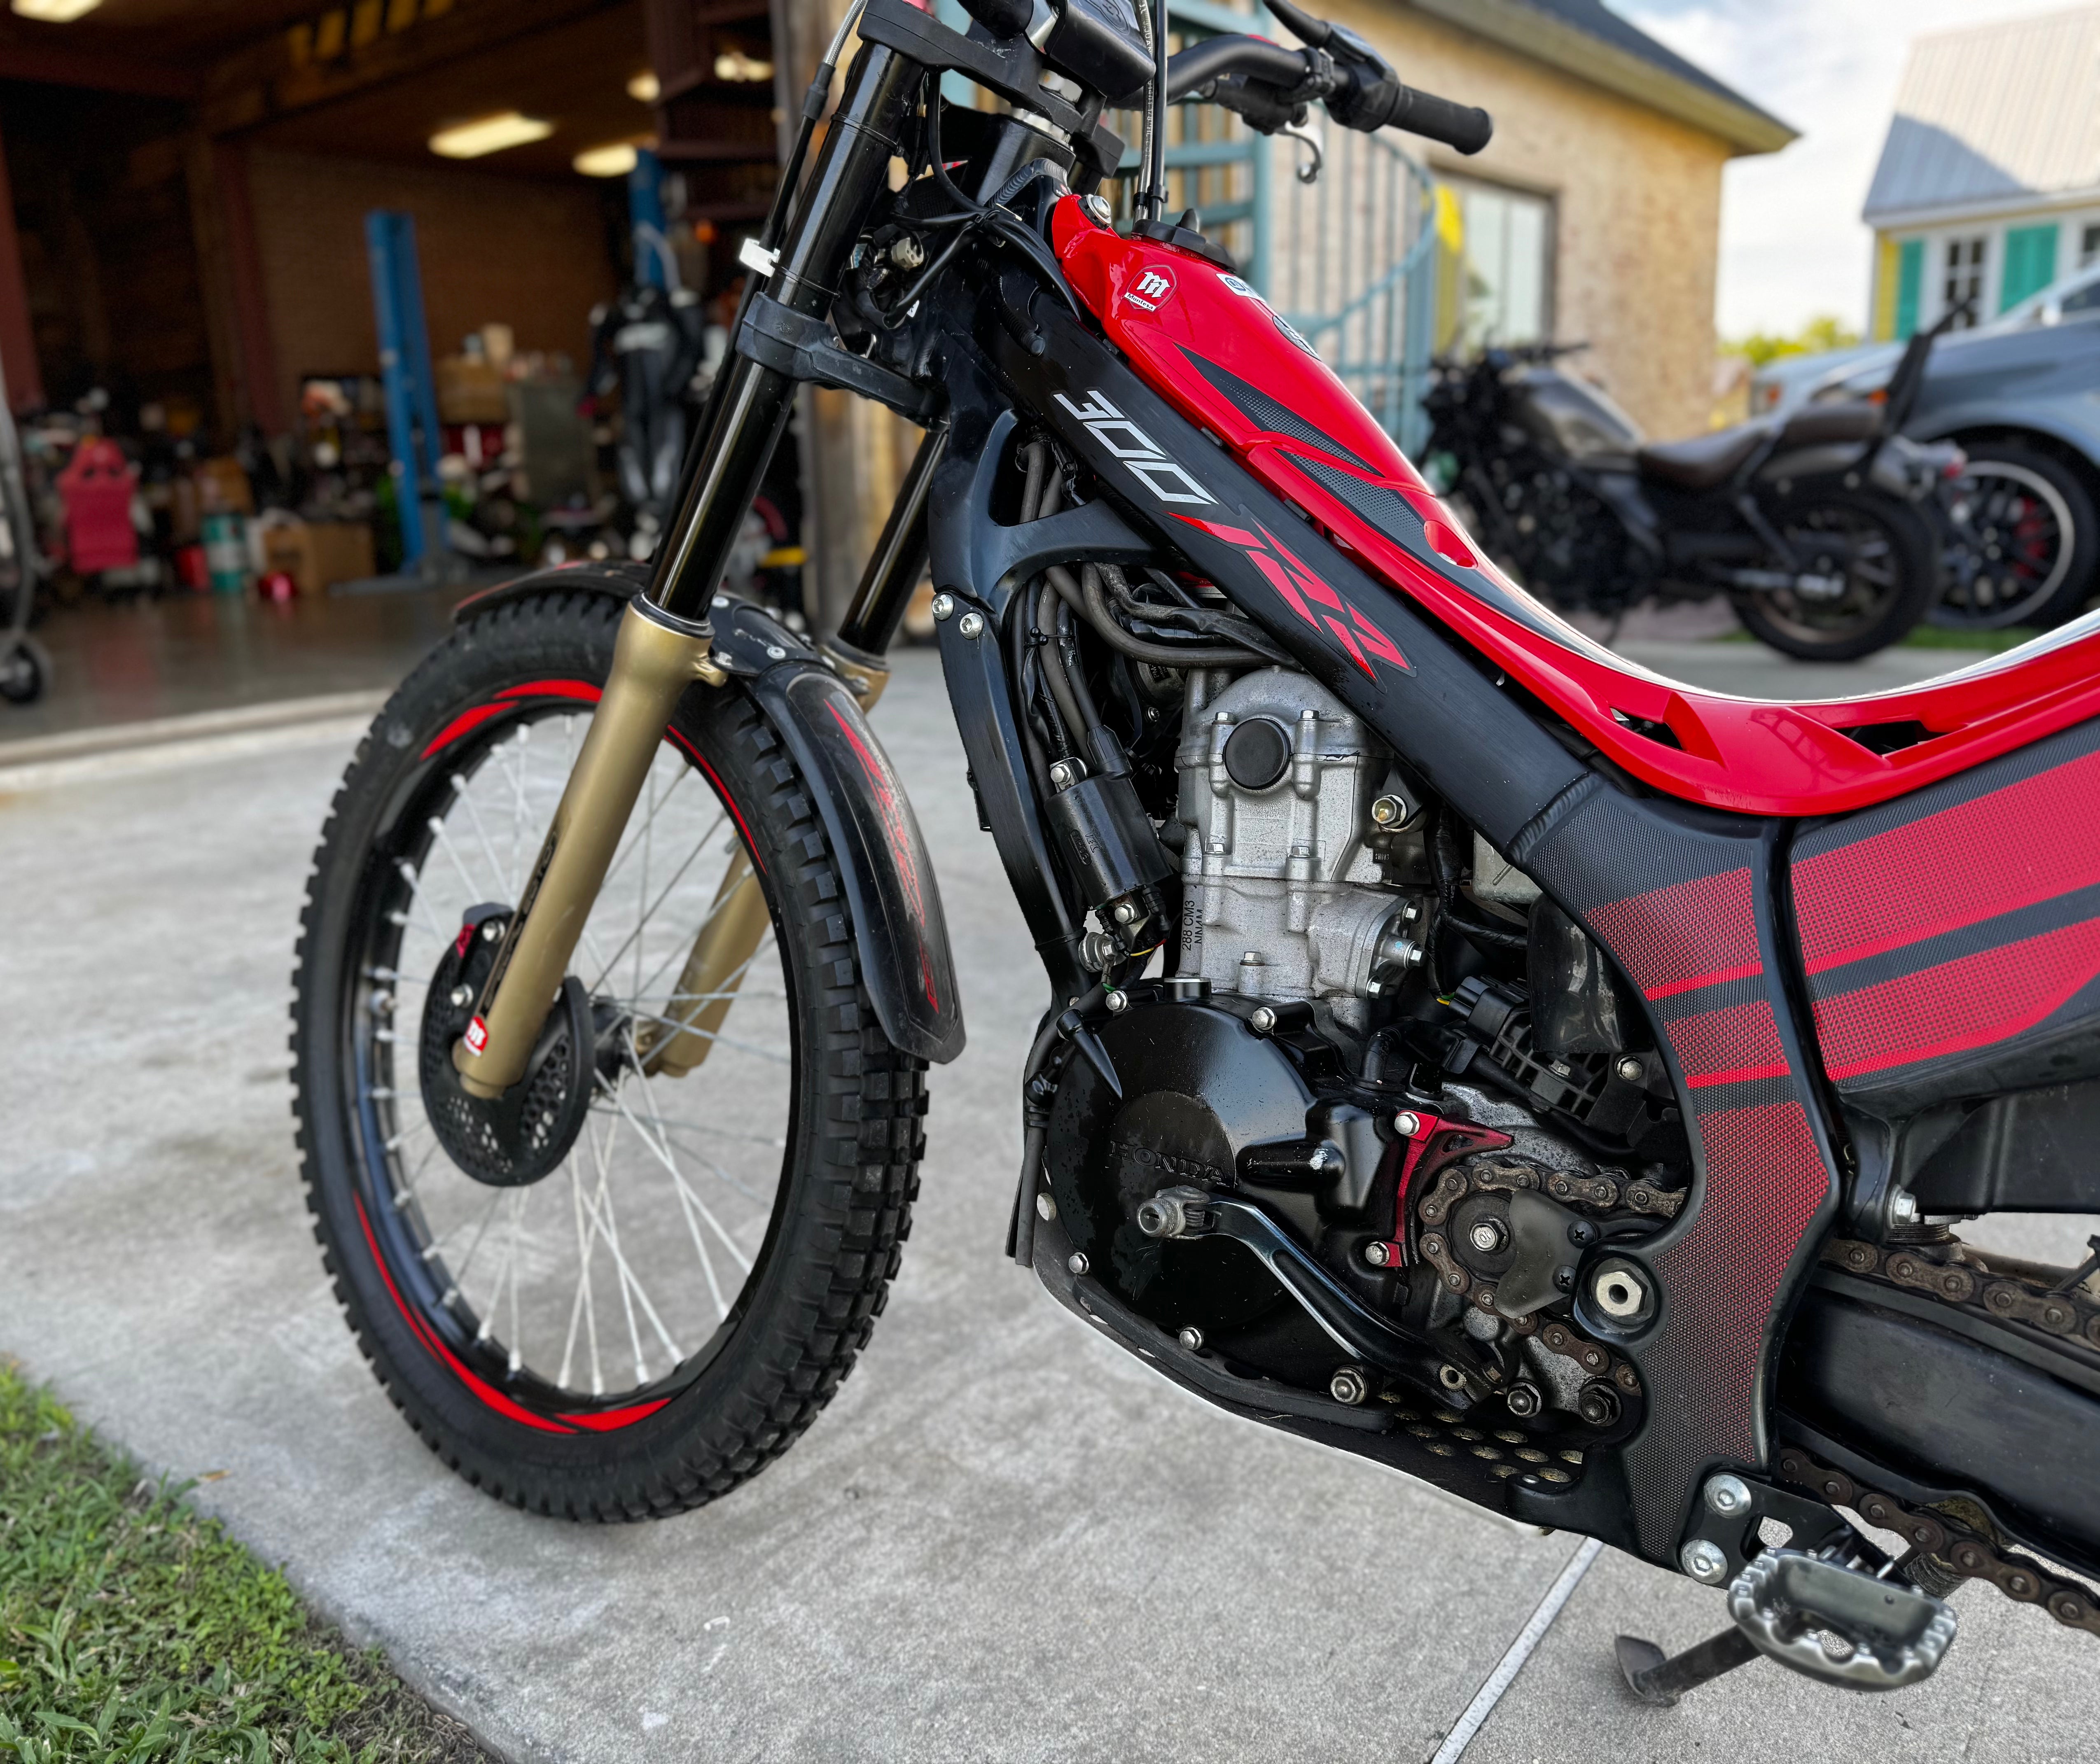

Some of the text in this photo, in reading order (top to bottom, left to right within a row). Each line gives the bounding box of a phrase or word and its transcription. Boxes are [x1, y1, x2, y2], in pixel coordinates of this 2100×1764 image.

[1127, 293, 1154, 310] Montesa
[1053, 390, 1220, 505] 300
[1182, 900, 1195, 951] 288 CM3
[1109, 1139, 1231, 1188] HONDA
